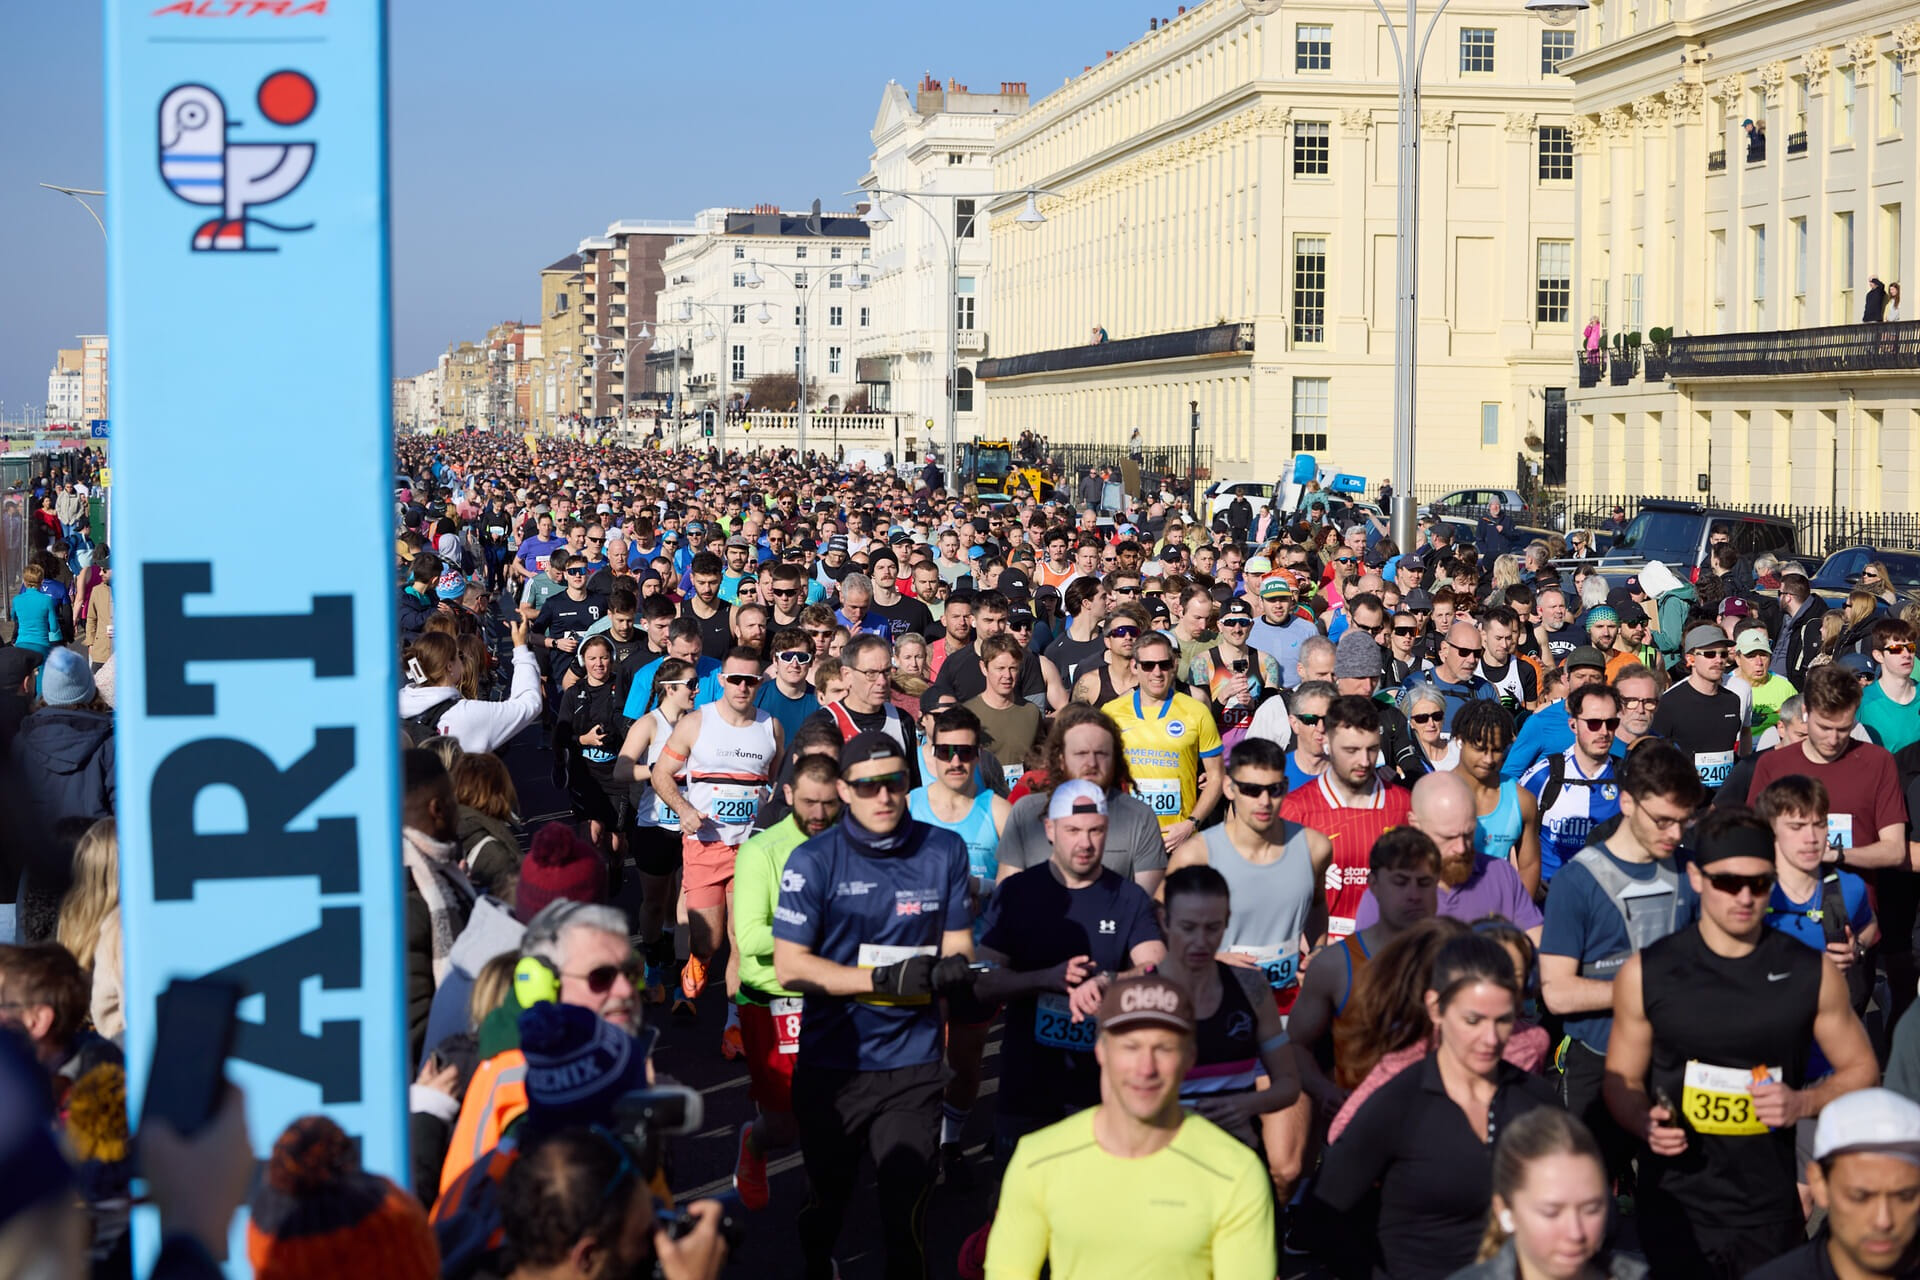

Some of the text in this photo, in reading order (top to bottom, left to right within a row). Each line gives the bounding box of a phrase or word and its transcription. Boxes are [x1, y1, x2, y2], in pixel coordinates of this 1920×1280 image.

[149, 0, 328, 17] ALTRA
[1223, 709, 1249, 724] 612
[1124, 748, 1180, 759] AMERICAN
[1131, 757, 1180, 768] EXPRESS
[717, 800, 753, 817] 2280
[1550, 817, 1599, 836] utilit
[142, 561, 363, 1160] ART
[1041, 1013, 1096, 1044] 2353
[1694, 1094, 1761, 1124] 353
